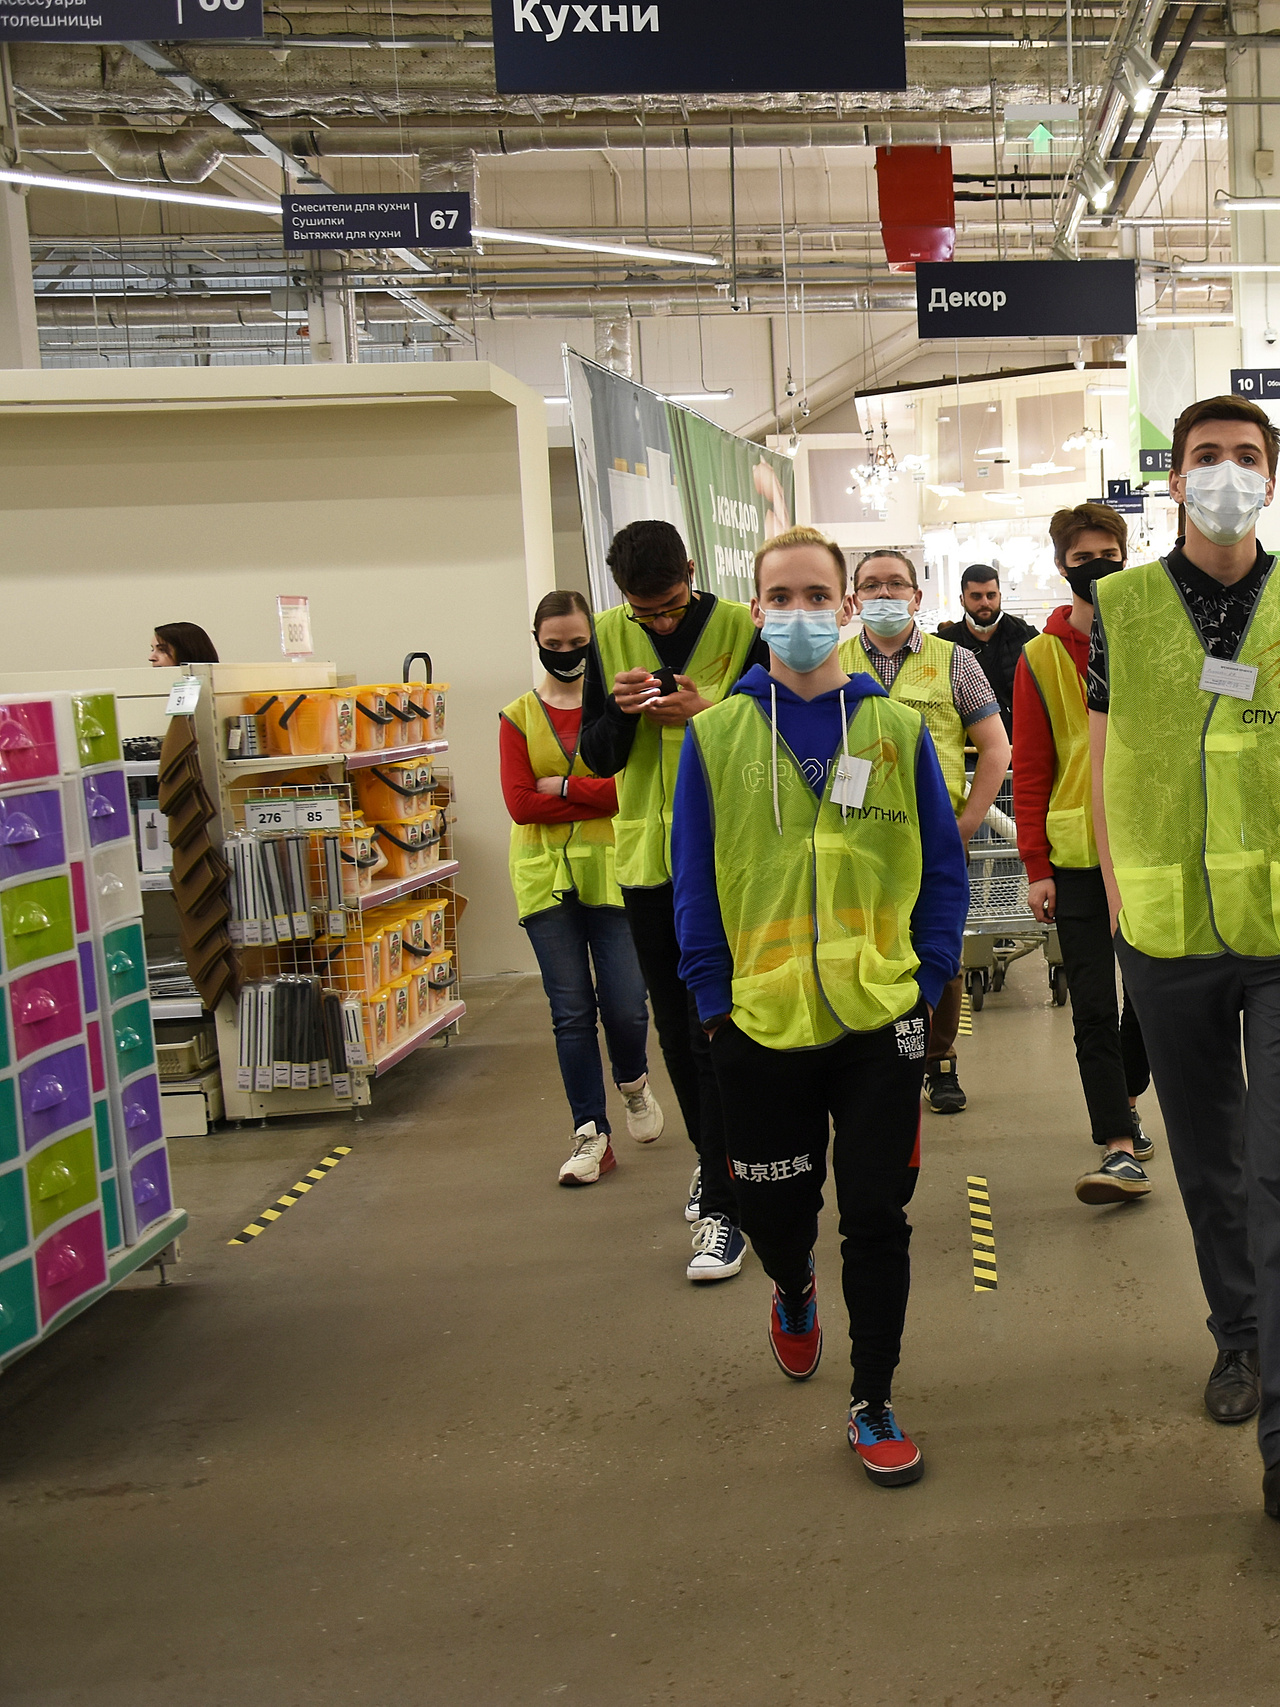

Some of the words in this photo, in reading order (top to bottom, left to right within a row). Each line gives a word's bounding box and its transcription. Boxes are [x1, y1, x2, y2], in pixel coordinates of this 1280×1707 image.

[513, 0, 660, 42] Кухни
[291, 203, 352, 213] Смесители
[354, 203, 376, 213] для
[377, 202, 410, 213] кухни
[292, 217, 345, 228] Сушилки
[430, 210, 459, 230] 67
[293, 231, 344, 240] Вытяжки
[345, 231, 366, 241] для
[368, 230, 401, 241] кухни
[928, 288, 1007, 312] Декор
[1237, 378, 1254, 391] 10
[1146, 456, 1153, 466] 8
[1113, 485, 1120, 493] 7
[897, 699, 944, 711] ПУТНИК
[741, 757, 879, 793] CRO
[258, 812, 282, 824] 276
[307, 811, 322, 822] 85
[893, 1017, 925, 1037] 東京
[732, 1153, 812, 1182] 東京狂気
